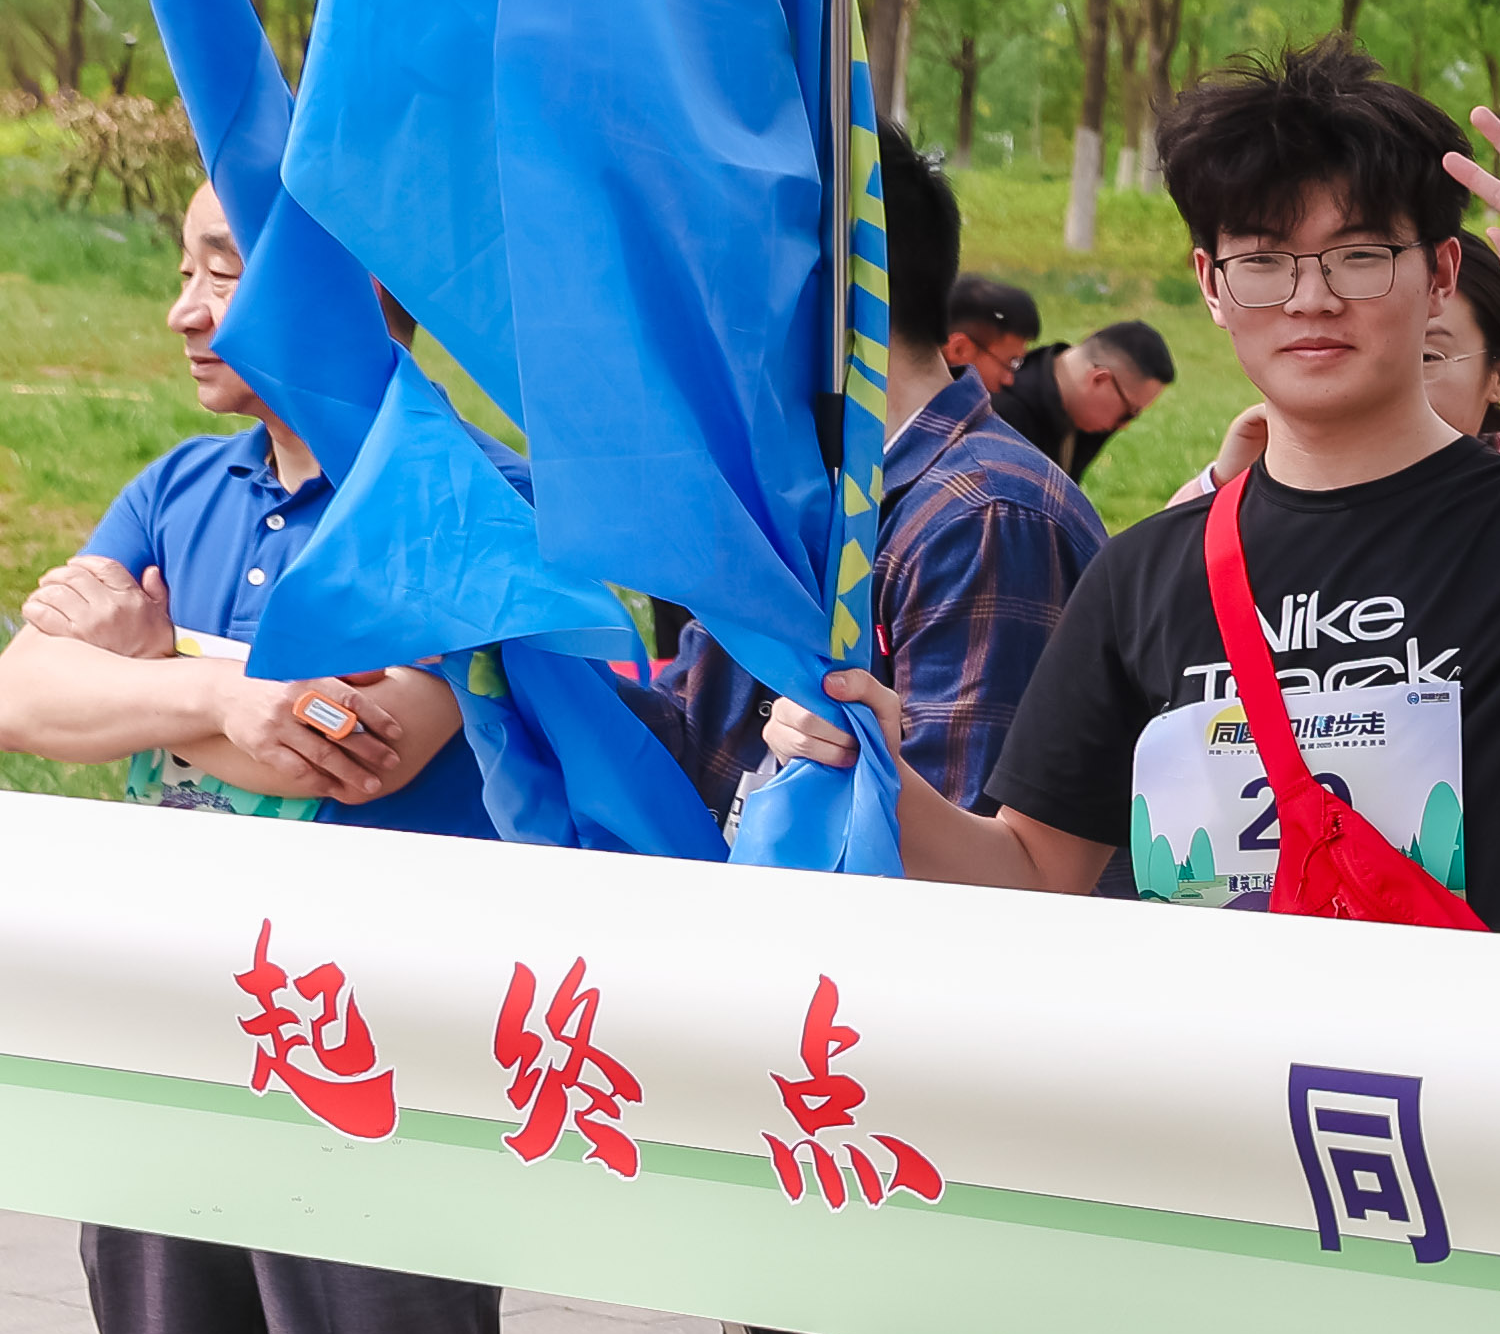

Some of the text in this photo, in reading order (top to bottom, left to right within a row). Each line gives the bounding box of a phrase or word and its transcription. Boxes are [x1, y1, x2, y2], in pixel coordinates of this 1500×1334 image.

[1255, 590, 1405, 653] Nike
[234, 917, 945, 1213] 起终点
